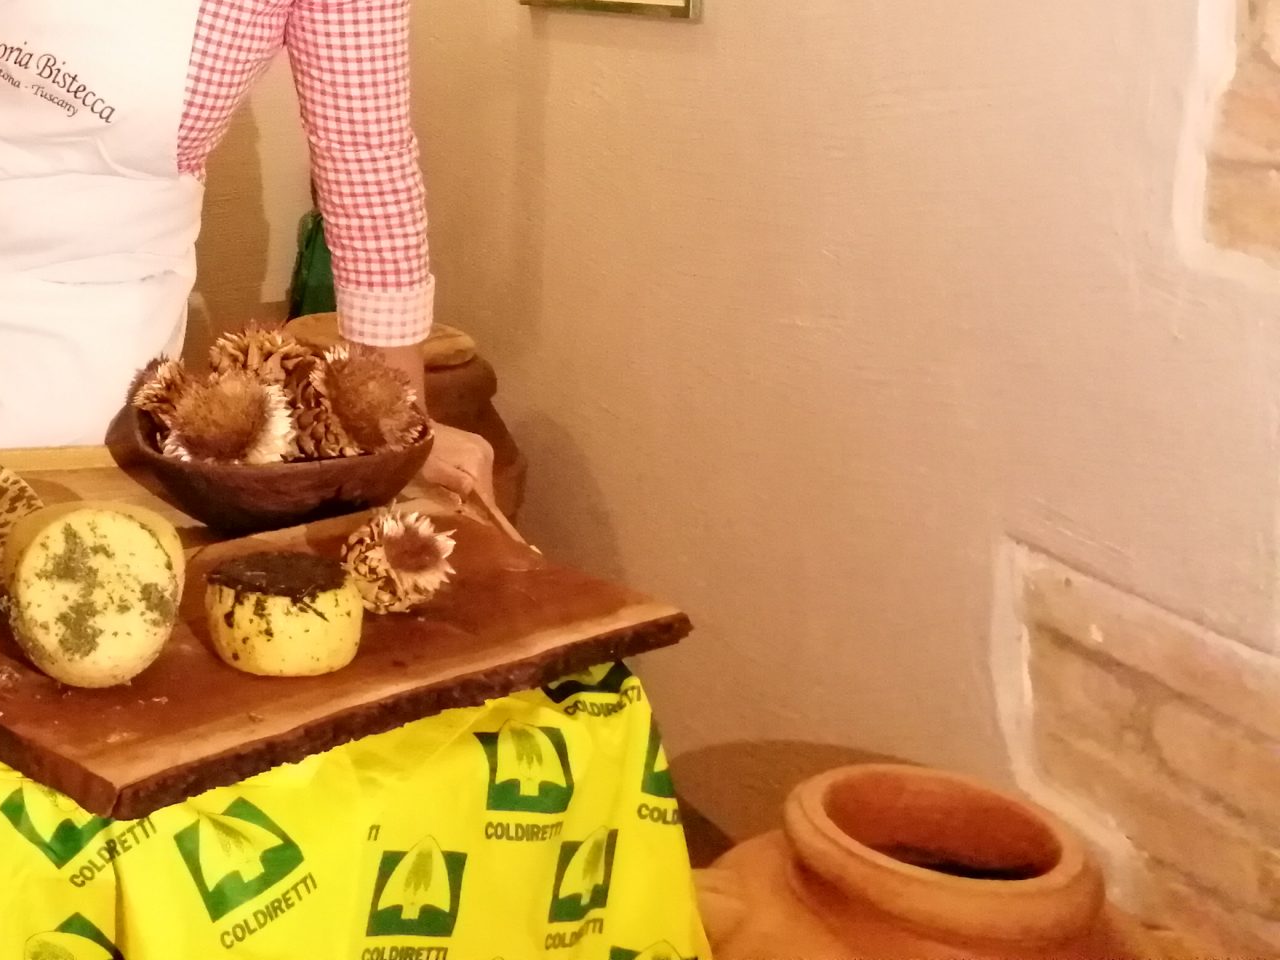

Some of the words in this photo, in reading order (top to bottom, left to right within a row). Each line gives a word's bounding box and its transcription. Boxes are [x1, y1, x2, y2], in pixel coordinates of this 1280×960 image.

[31, 83, 80, 118] Tuscany
[36, 52, 116, 125] Bistecca
[484, 821, 564, 843] COLDIRETTI
[219, 873, 319, 950] COLDIRETTI
